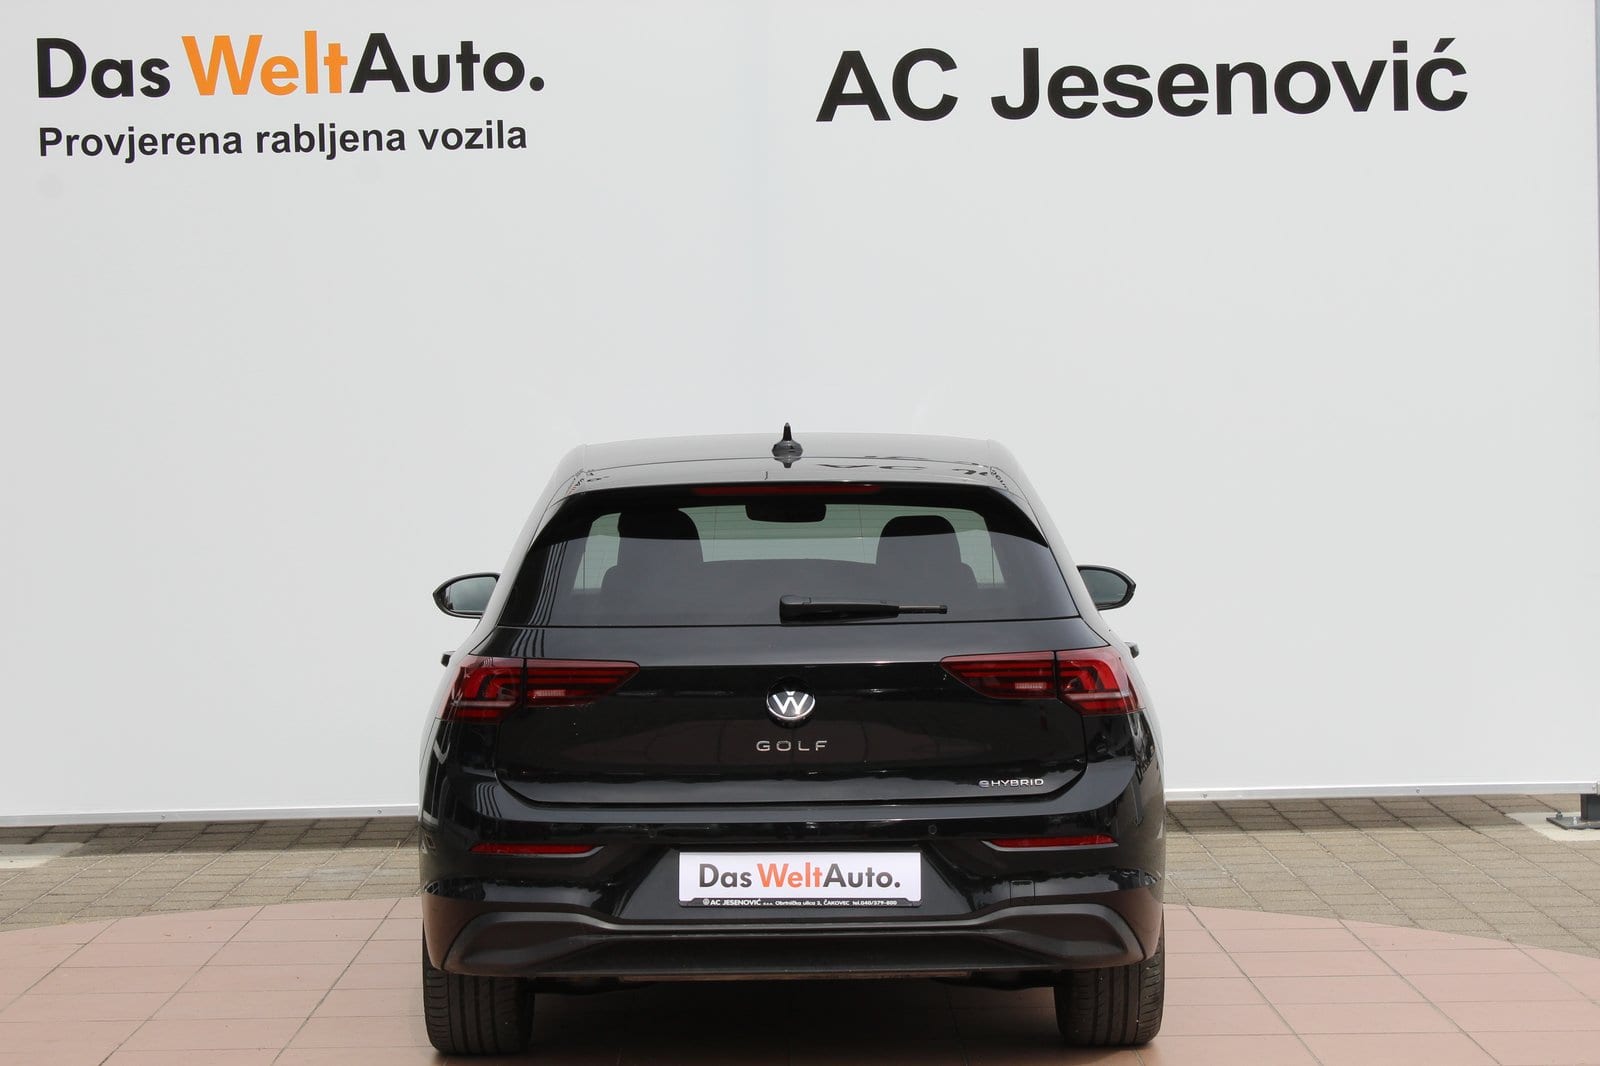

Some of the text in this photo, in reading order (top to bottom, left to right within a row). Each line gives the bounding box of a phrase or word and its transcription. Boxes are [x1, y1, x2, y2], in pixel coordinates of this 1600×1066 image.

[37, 31, 544, 98] Das WeltAuto.
[816, 38, 1467, 122] AC Jesenović
[40, 120, 527, 163] Provjerena rabljena vozila
[756, 740, 828, 752] GOLF
[699, 862, 901, 888] Das WeltAuto.
[722, 898, 761, 906] JESENOVIĆ
[823, 898, 850, 906] ČAKOVEC
